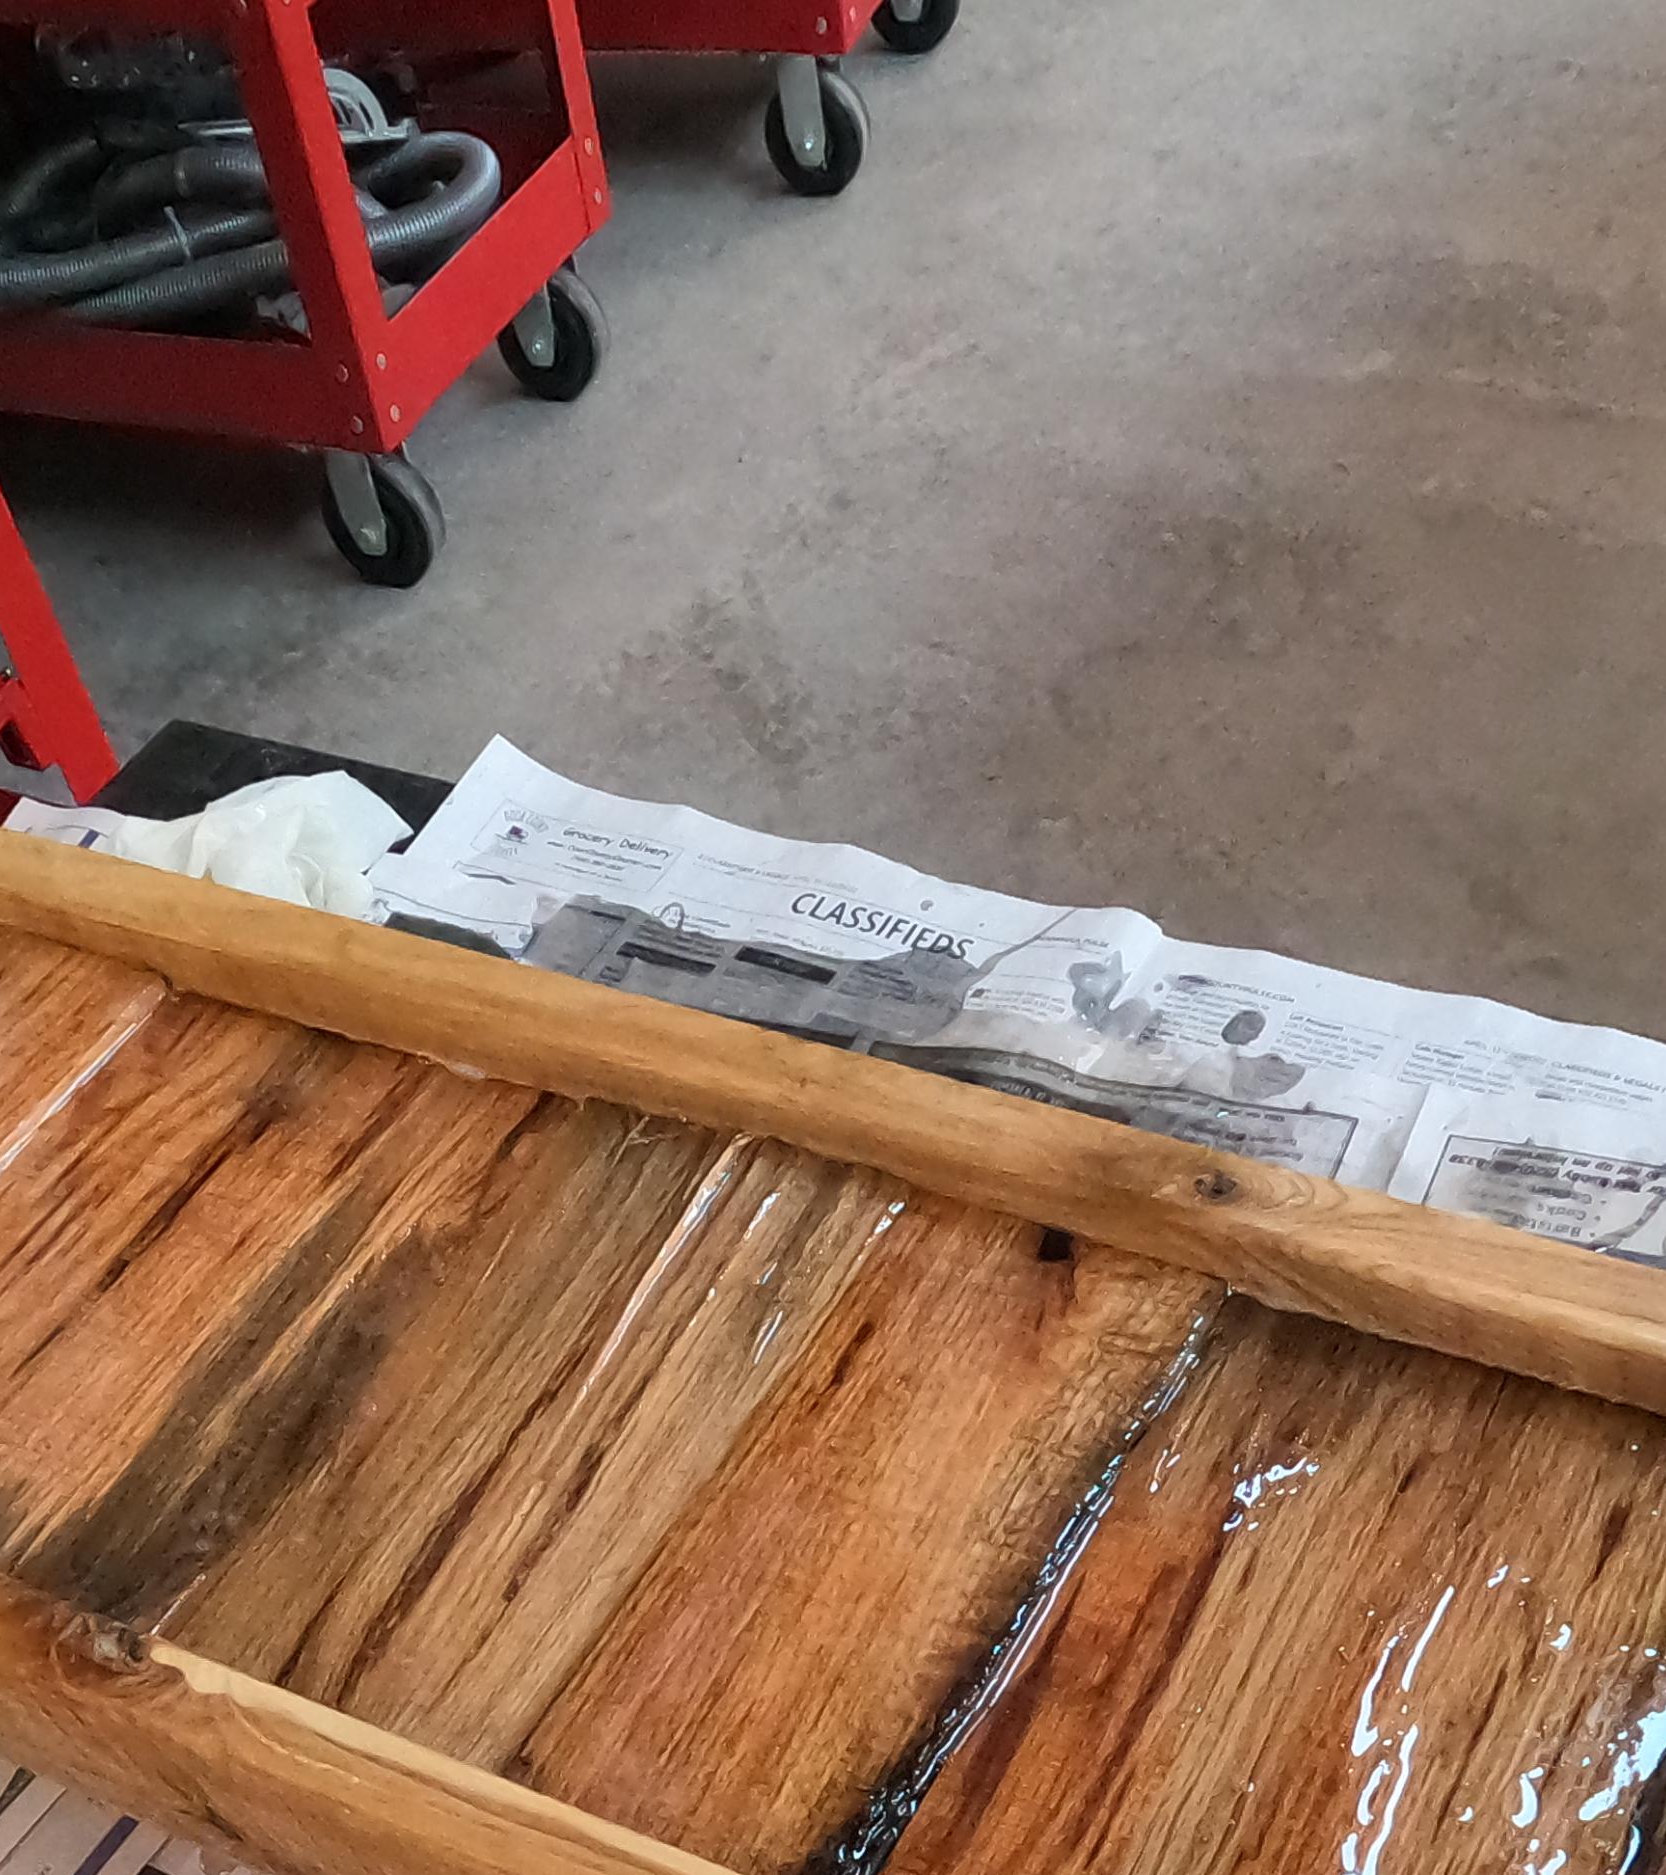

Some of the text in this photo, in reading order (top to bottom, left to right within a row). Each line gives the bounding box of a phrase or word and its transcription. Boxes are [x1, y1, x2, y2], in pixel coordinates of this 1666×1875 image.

[561, 825, 674, 860] Grocery Delivery
[791, 893, 974, 960] CLASSIFIEDS
